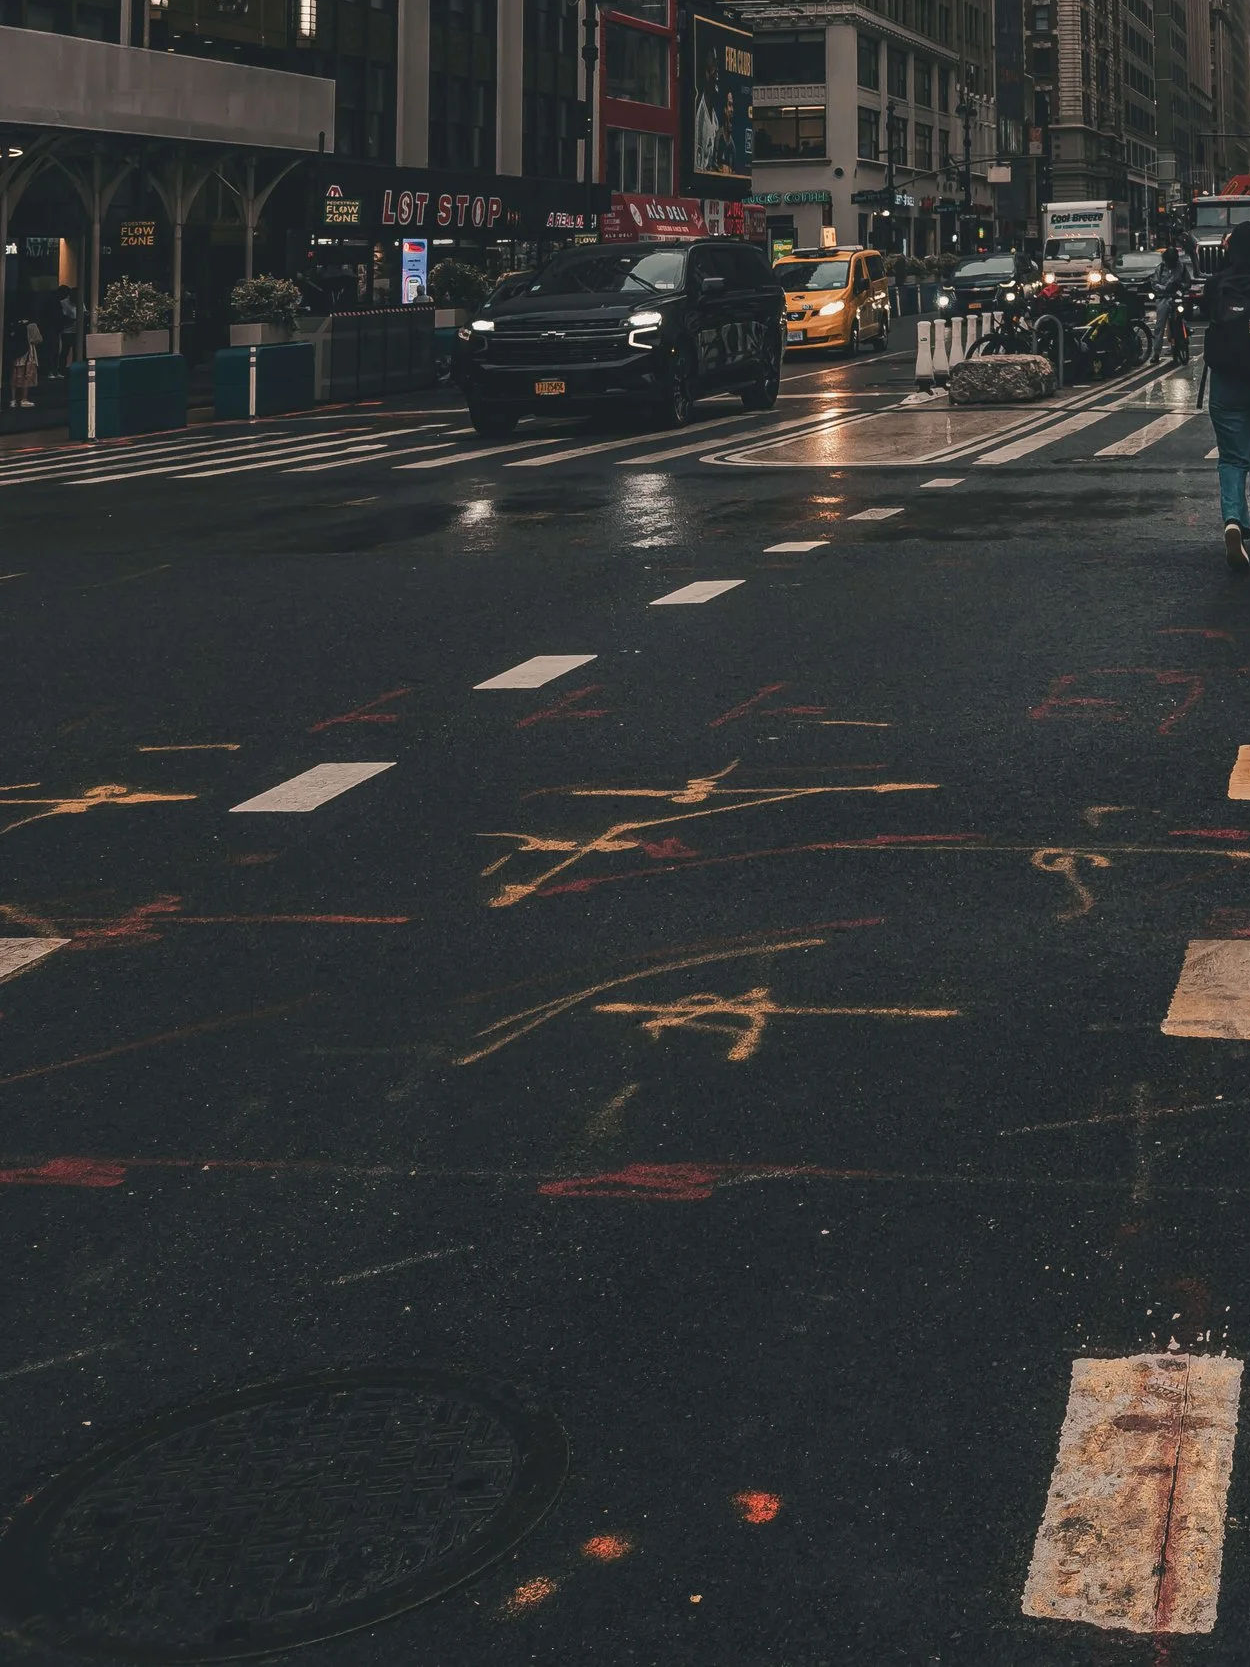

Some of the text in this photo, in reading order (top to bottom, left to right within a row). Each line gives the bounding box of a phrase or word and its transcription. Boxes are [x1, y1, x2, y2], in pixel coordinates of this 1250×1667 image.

[326, 206, 359, 214] FLOW
[382, 190, 430, 226] LOT
[437, 194, 503, 228] STOP
[666, 205, 689, 221] DELI
[326, 214, 359, 223] ZONE
[1051, 213, 1104, 224] Cool Breeze
[121, 226, 155, 236] FLOW
[121, 236, 155, 246] ZONE
